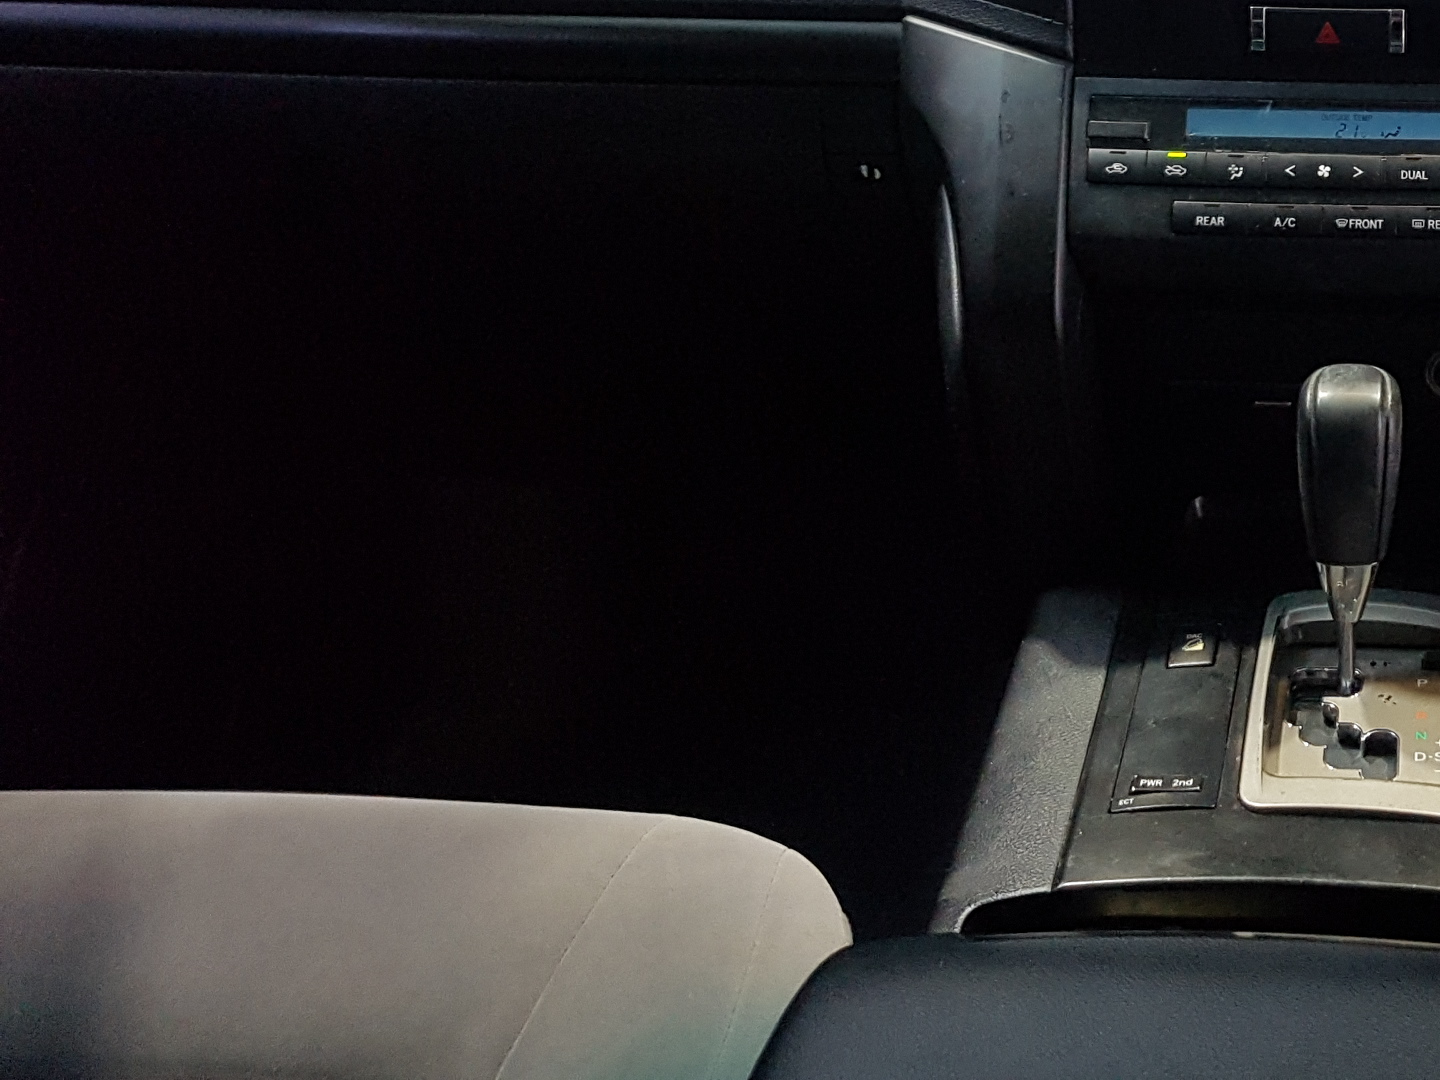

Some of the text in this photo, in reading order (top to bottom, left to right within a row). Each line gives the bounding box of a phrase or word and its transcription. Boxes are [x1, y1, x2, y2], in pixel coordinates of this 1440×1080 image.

[1401, 169, 1428, 180] DUAL
[1196, 215, 1225, 226] REAR
[1274, 216, 1296, 227] A/C
[1349, 218, 1384, 229] FRONT
[1417, 678, 1428, 687] P
[1415, 731, 1427, 740] N
[1140, 777, 1193, 787] PWR 2nd
